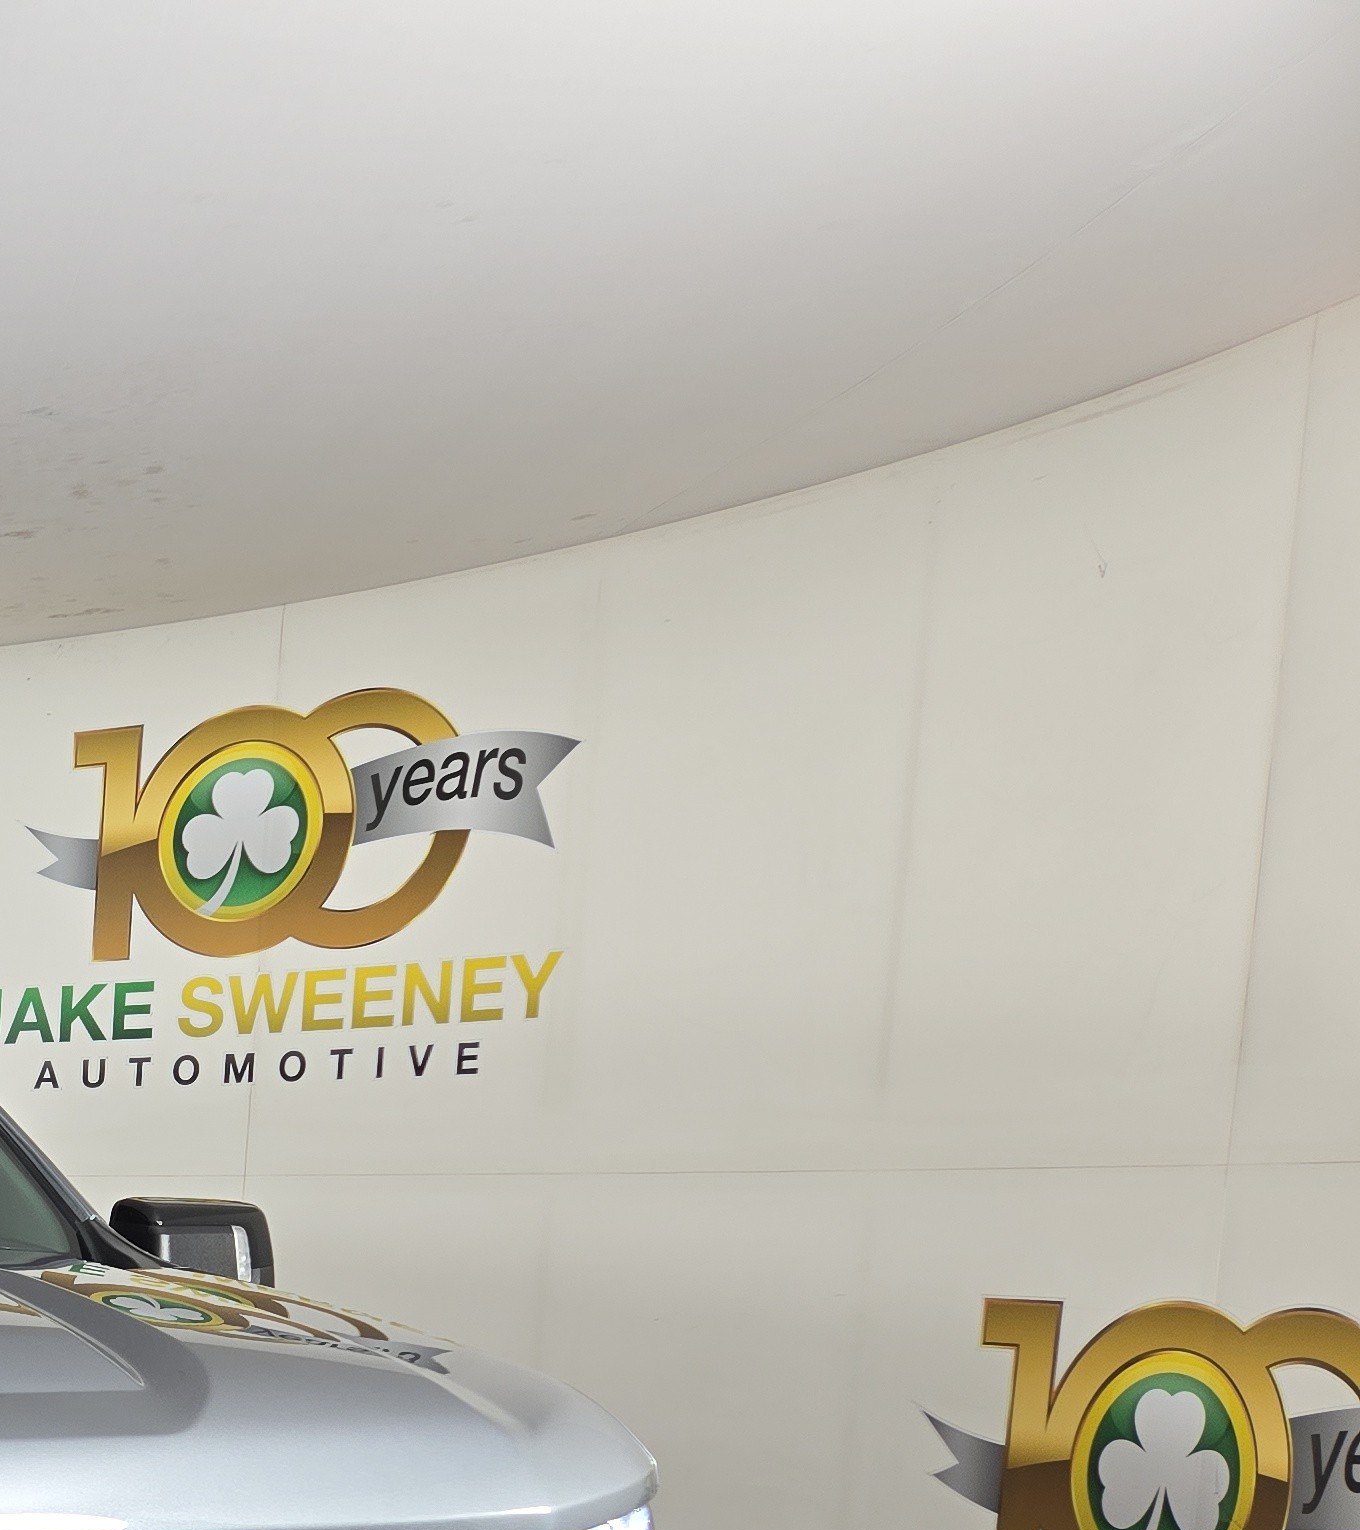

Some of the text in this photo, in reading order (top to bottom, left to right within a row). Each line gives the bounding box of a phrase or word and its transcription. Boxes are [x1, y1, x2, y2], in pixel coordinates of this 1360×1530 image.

[365, 744, 528, 831] years
[177, 951, 565, 1038] SWEENEY
[33, 1041, 481, 1090] AUTOMOTIVE
